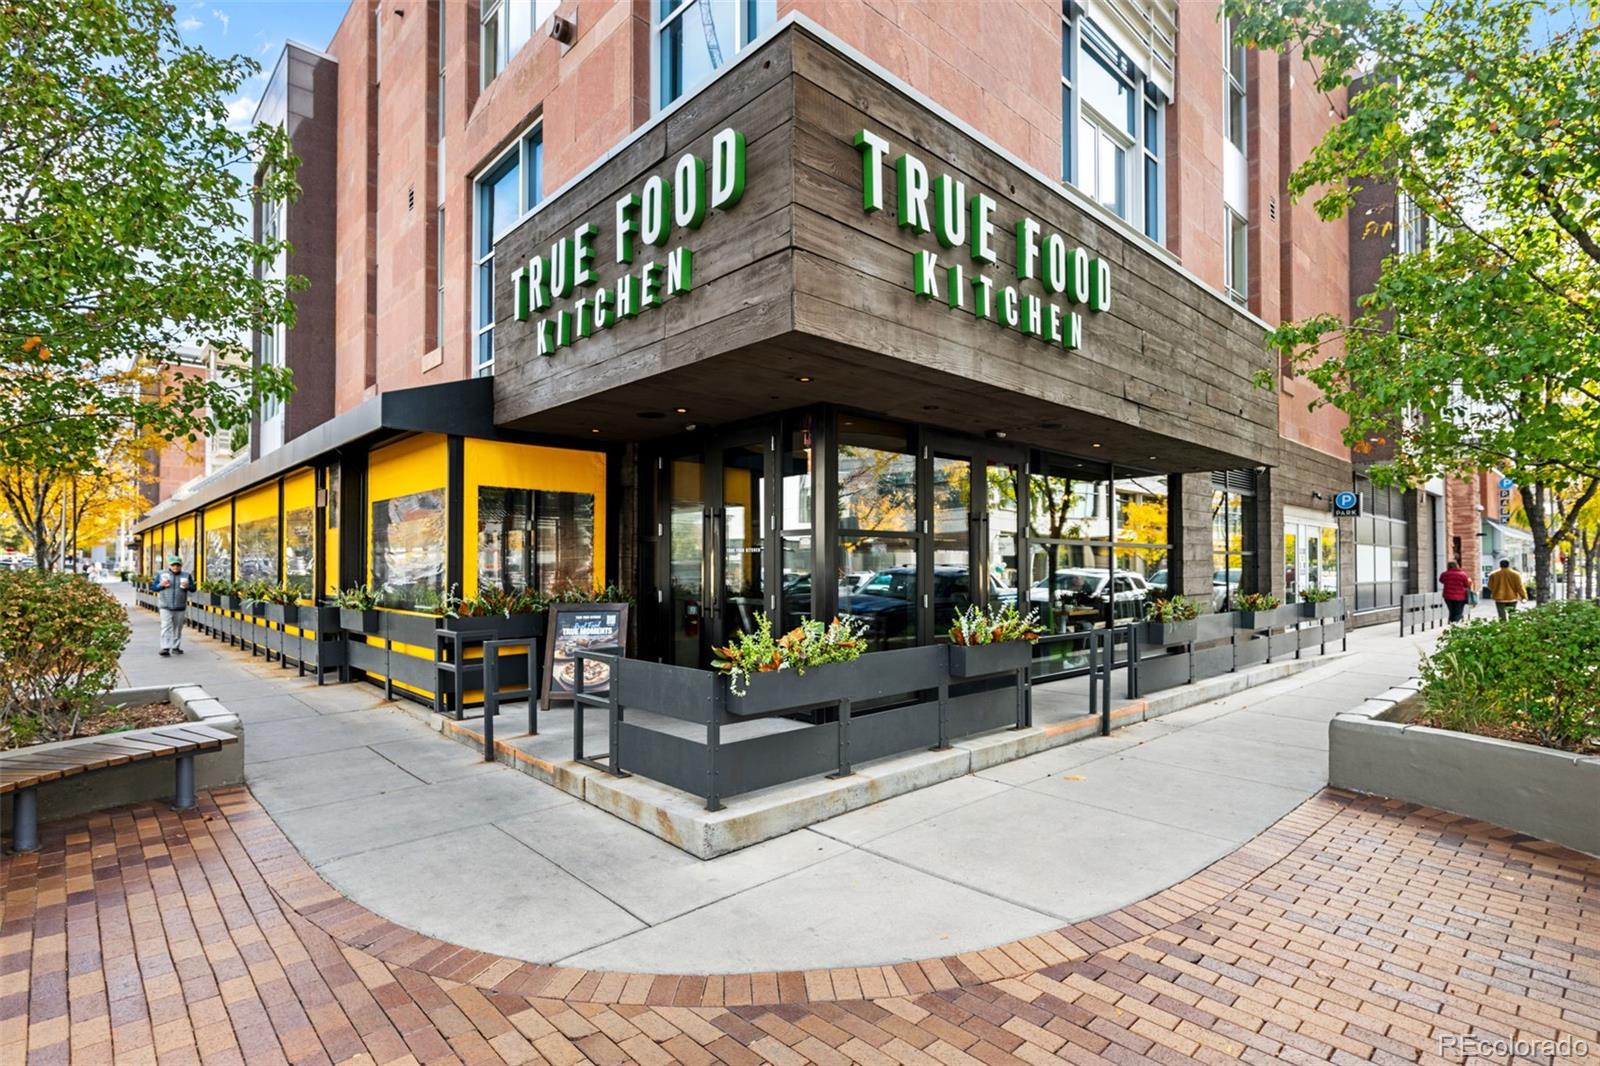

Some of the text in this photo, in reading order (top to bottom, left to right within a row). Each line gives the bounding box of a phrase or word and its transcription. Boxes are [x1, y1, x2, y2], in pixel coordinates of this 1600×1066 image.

[511, 127, 745, 321] TRUE FOOD
[854, 129, 1111, 313] TRUE FOOD
[537, 246, 692, 356] KITCHEN
[914, 249, 1082, 350] KITCHEN
[1341, 494, 1352, 506] P
[580, 627, 613, 635] MOMENTS
